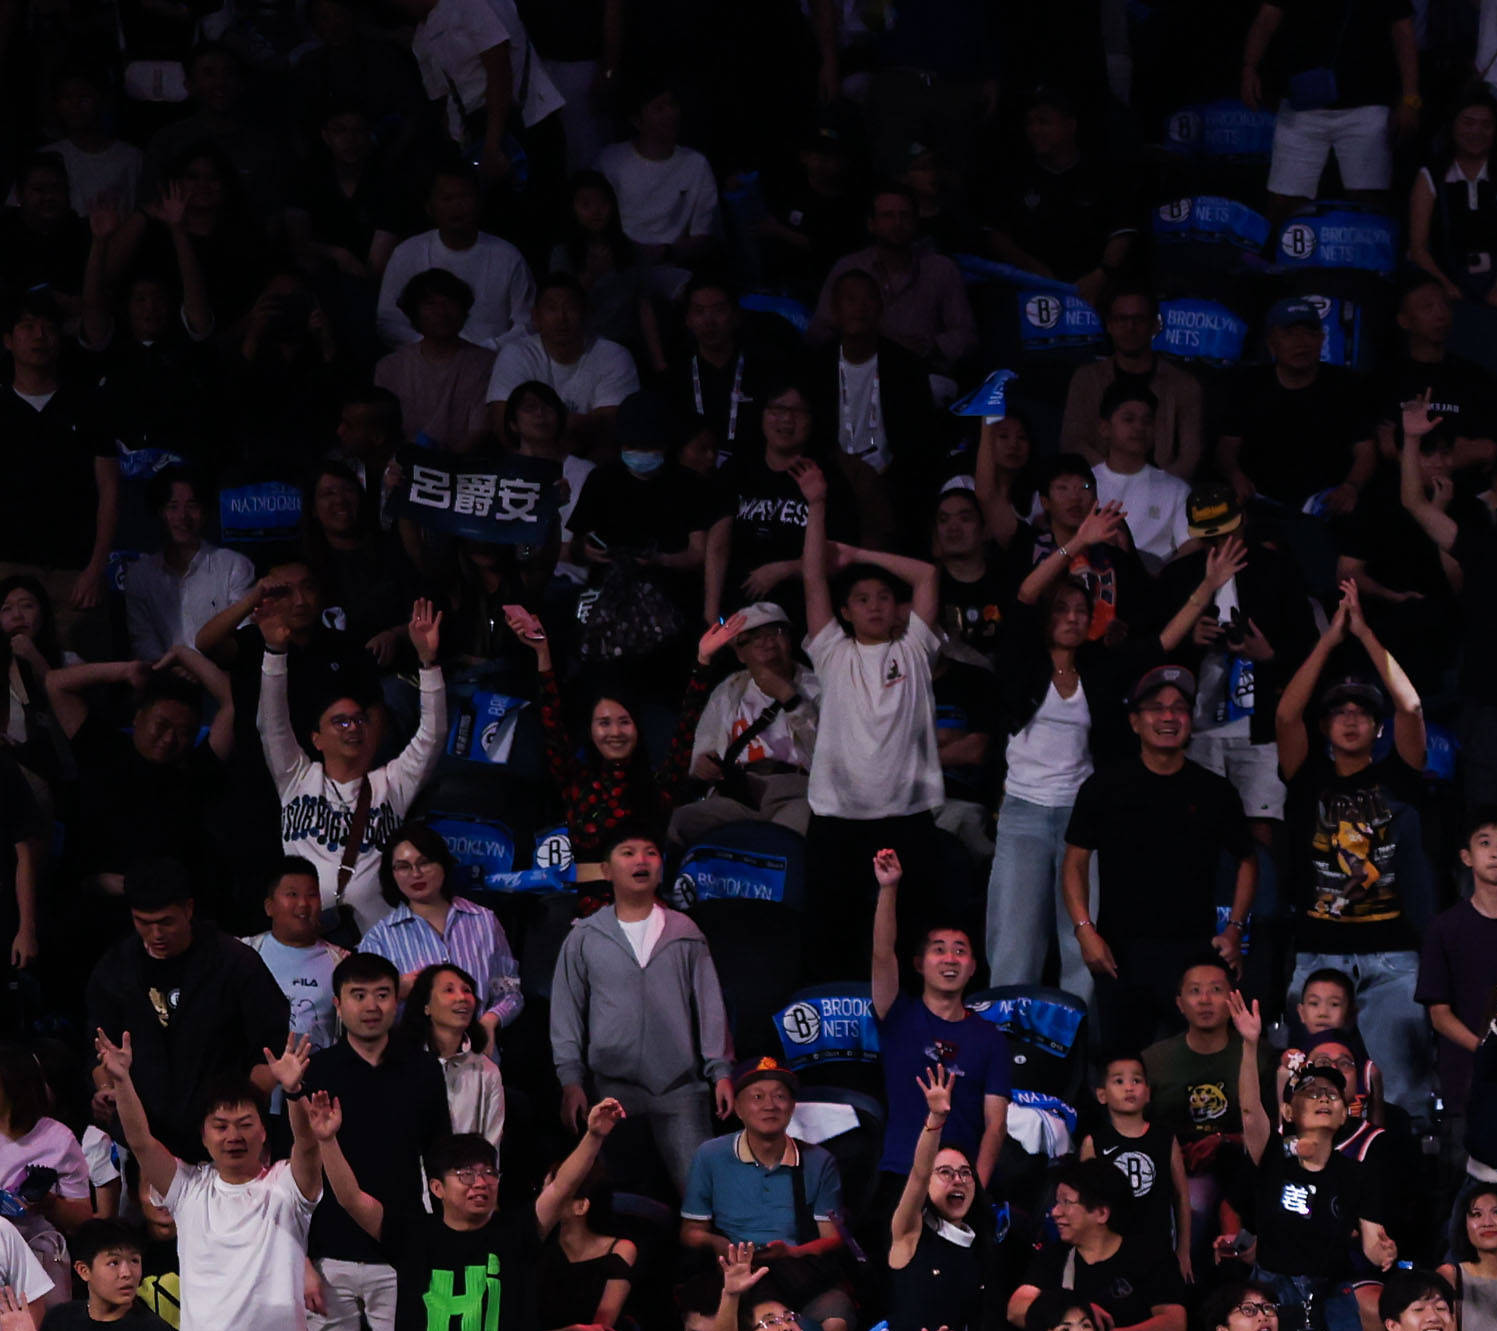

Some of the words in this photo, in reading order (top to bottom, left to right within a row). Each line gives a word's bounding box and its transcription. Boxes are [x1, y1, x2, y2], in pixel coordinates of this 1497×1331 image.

[1167, 309, 1240, 333] BROOKLYN
[1164, 328, 1201, 348] NETS
[292, 977, 319, 988] FILA
[819, 996, 875, 1019] BROOK
[821, 1018, 860, 1041] NETS
